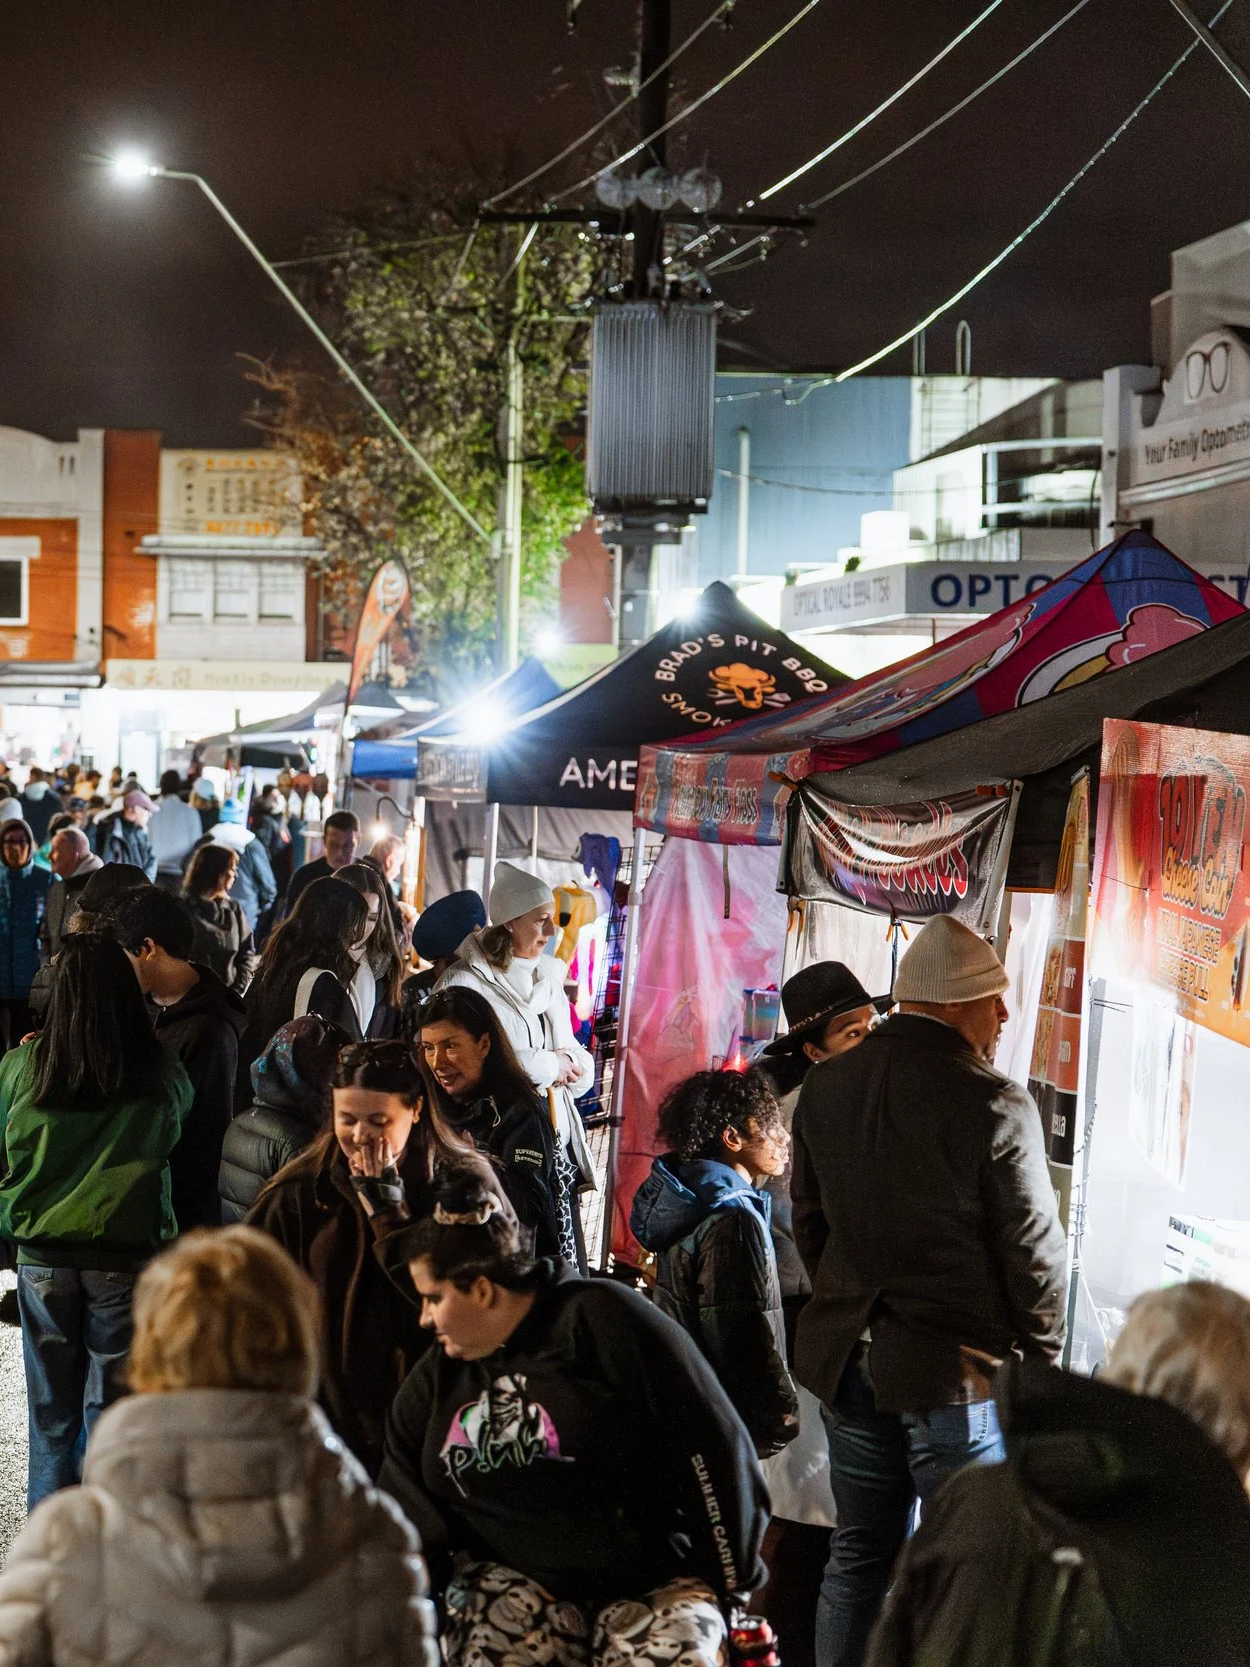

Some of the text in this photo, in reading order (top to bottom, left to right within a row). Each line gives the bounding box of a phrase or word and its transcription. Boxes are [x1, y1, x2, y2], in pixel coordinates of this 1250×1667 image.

[1169, 434, 1199, 462] Family
[655, 633, 829, 693] BRAD'S PIT BBQ
[559, 757, 638, 791] AME
[691, 1453, 722, 1524] SUMMER
